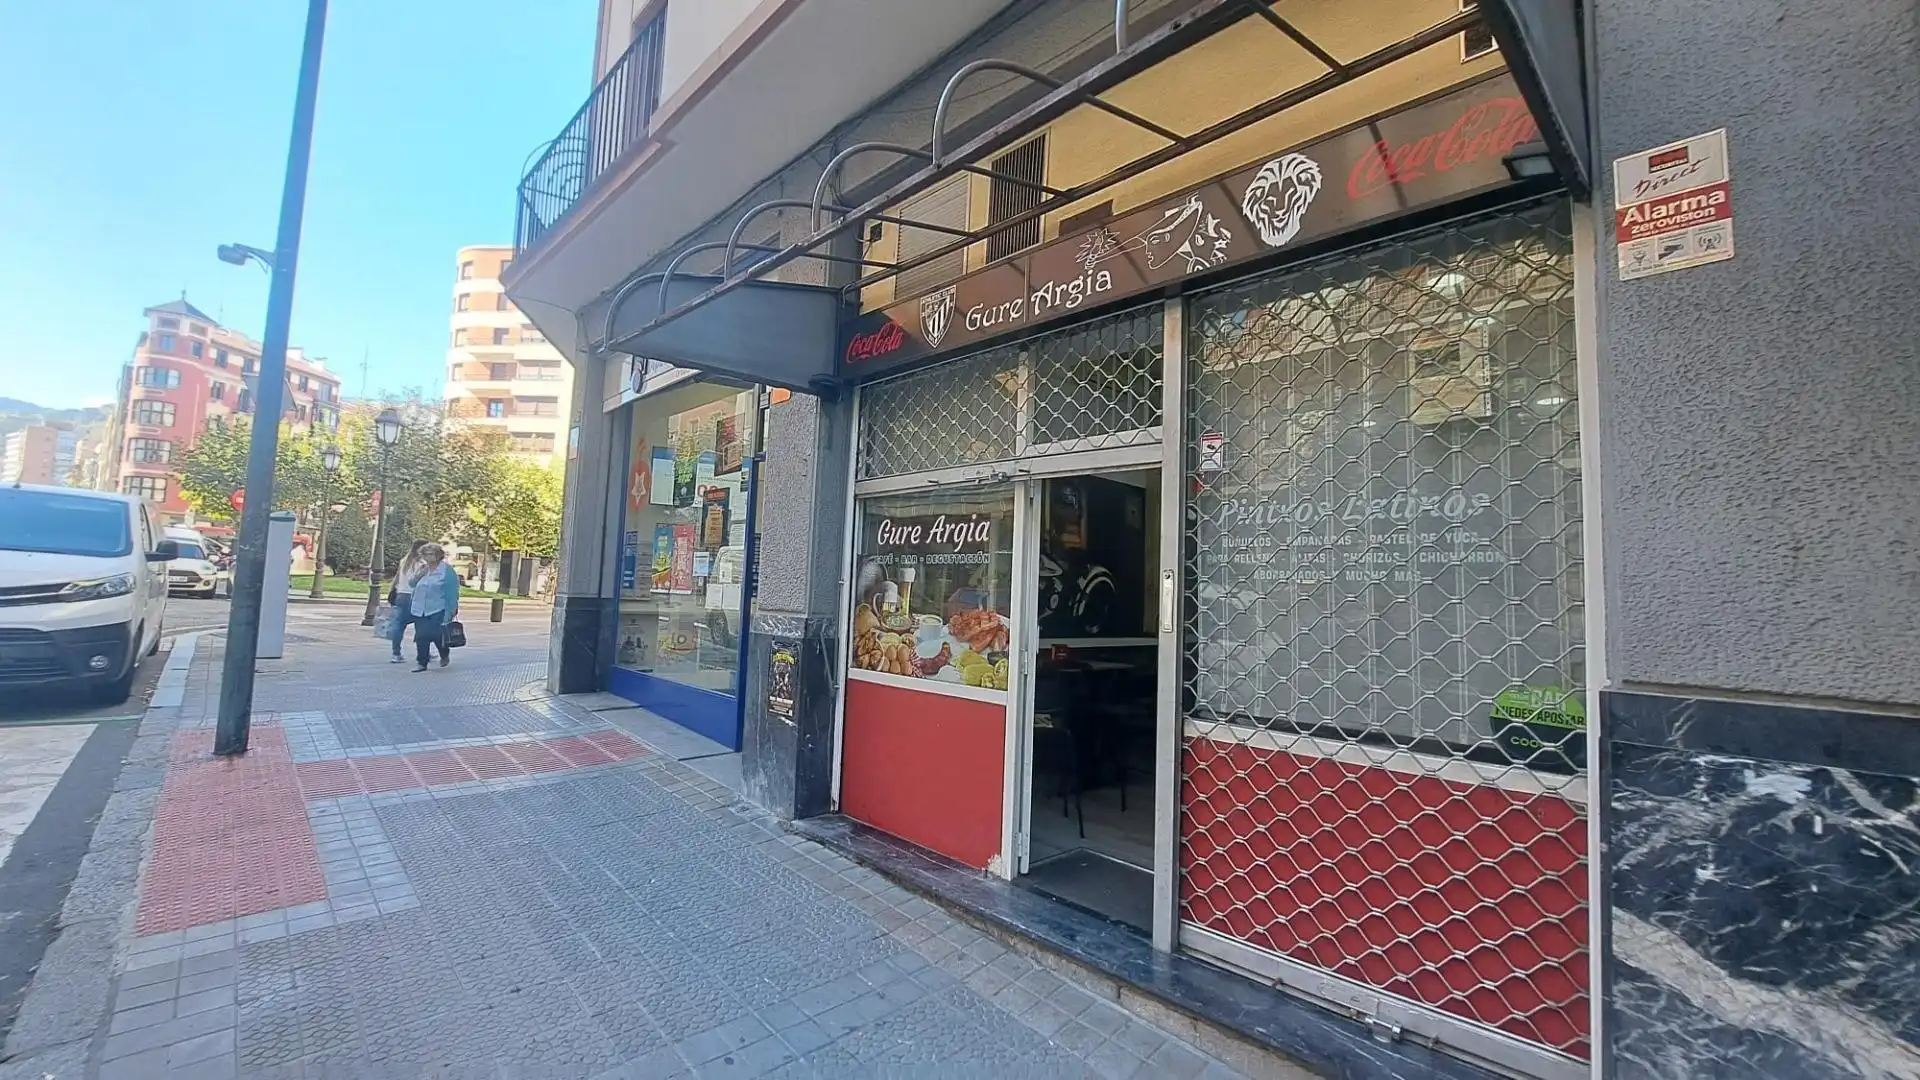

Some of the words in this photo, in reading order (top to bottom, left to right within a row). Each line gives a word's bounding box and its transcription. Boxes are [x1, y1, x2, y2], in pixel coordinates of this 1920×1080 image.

[1622, 190, 1726, 227] Alarma
[1631, 206, 1716, 234] zerovision
[965, 297, 1024, 331] Gure
[1031, 269, 1112, 316] Argia
[877, 519, 922, 545] Gure
[926, 513, 991, 553] Argia
